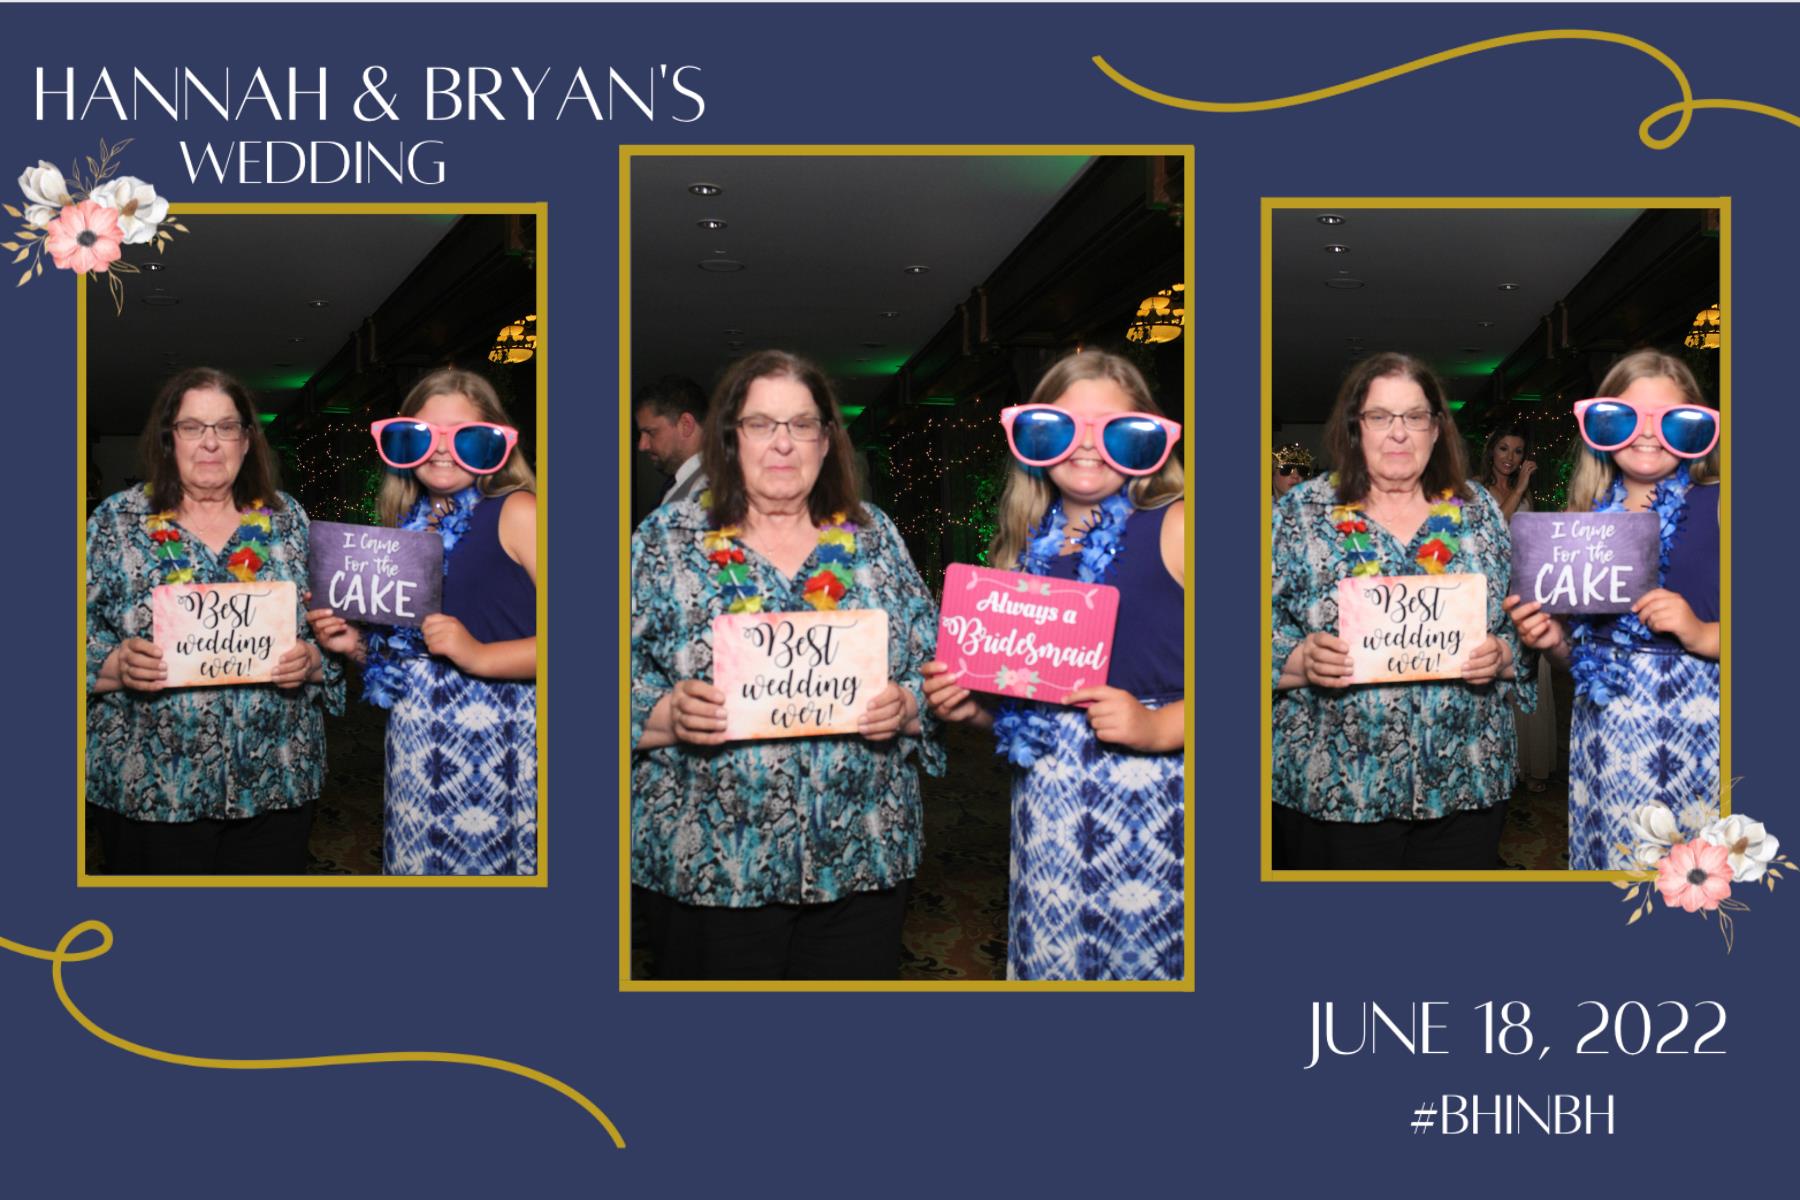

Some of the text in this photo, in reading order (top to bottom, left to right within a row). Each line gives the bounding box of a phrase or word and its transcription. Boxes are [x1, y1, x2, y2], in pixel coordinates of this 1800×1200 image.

[342, 532, 401, 552] I Came
[1551, 521, 1616, 542] I Came
[344, 555, 399, 577] For the
[1553, 541, 1616, 565] For the
[328, 570, 418, 618] CAKE
[1534, 563, 1634, 607] CAKE
[178, 590, 272, 630] Best
[976, 590, 1077, 625] Always a
[1364, 582, 1462, 625] Best
[176, 629, 275, 660] wedding
[743, 619, 858, 669] Best
[942, 614, 1108, 670] Bridesmaid
[1362, 622, 1465, 656] wedding
[200, 656, 252, 678] ever!
[1387, 653, 1441, 674] ever!
[741, 666, 861, 706] wedding
[771, 703, 834, 729] ever!
